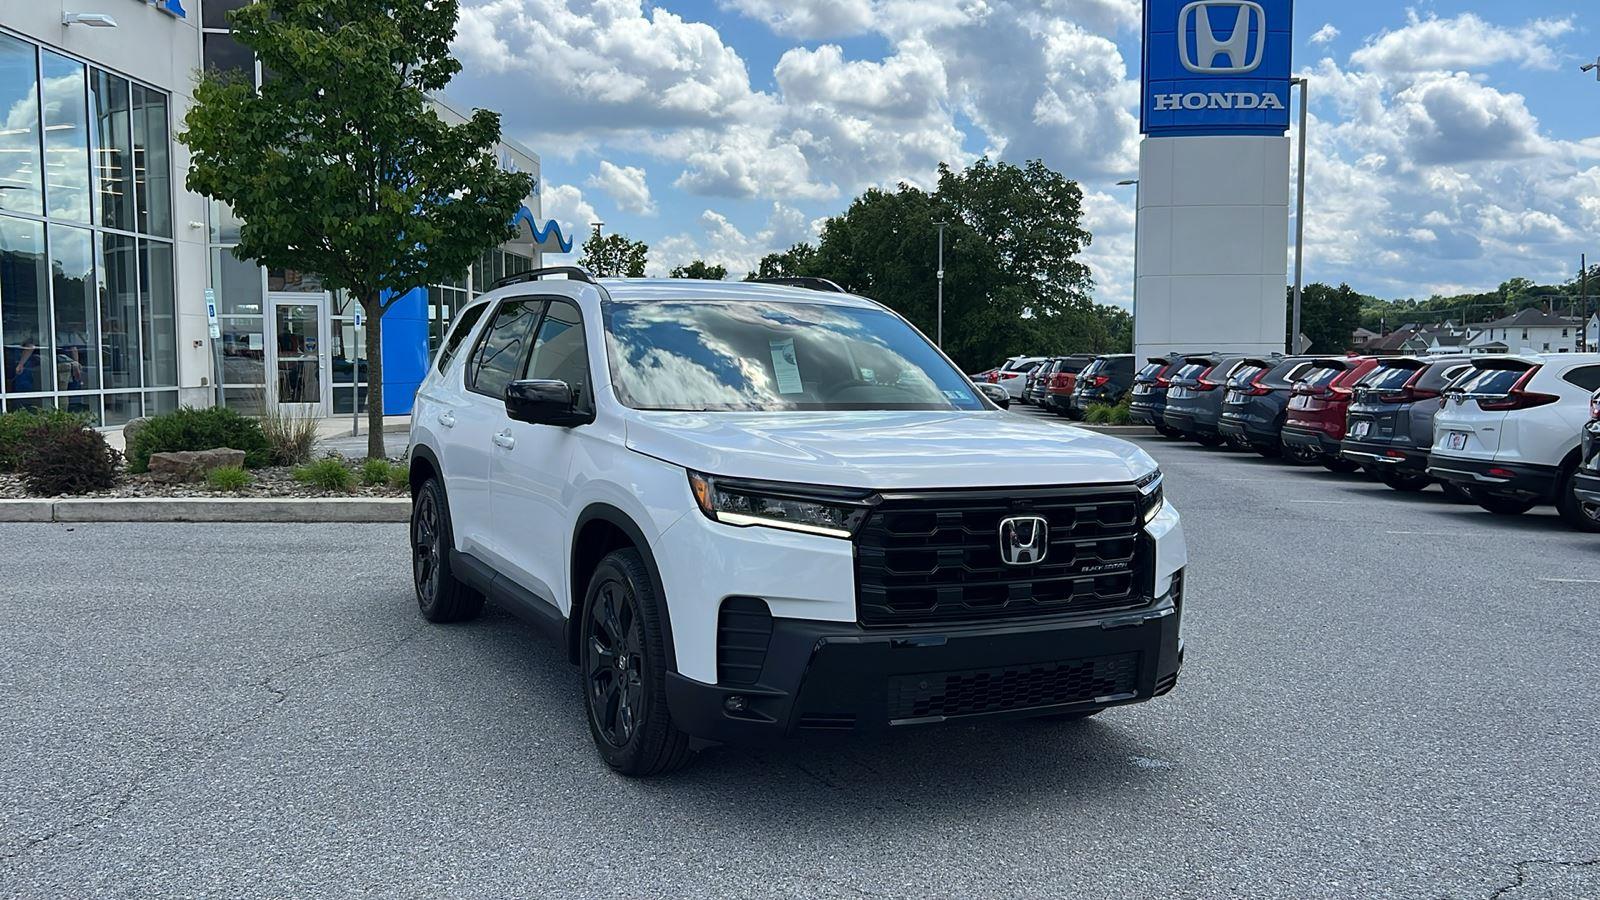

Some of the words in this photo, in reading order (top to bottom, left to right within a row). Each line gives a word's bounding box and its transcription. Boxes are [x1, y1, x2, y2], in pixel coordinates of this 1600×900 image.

[1153, 92, 1285, 111] HONDA
[1081, 564, 1103, 573] BLACK
[1104, 562, 1128, 570] EDITION
